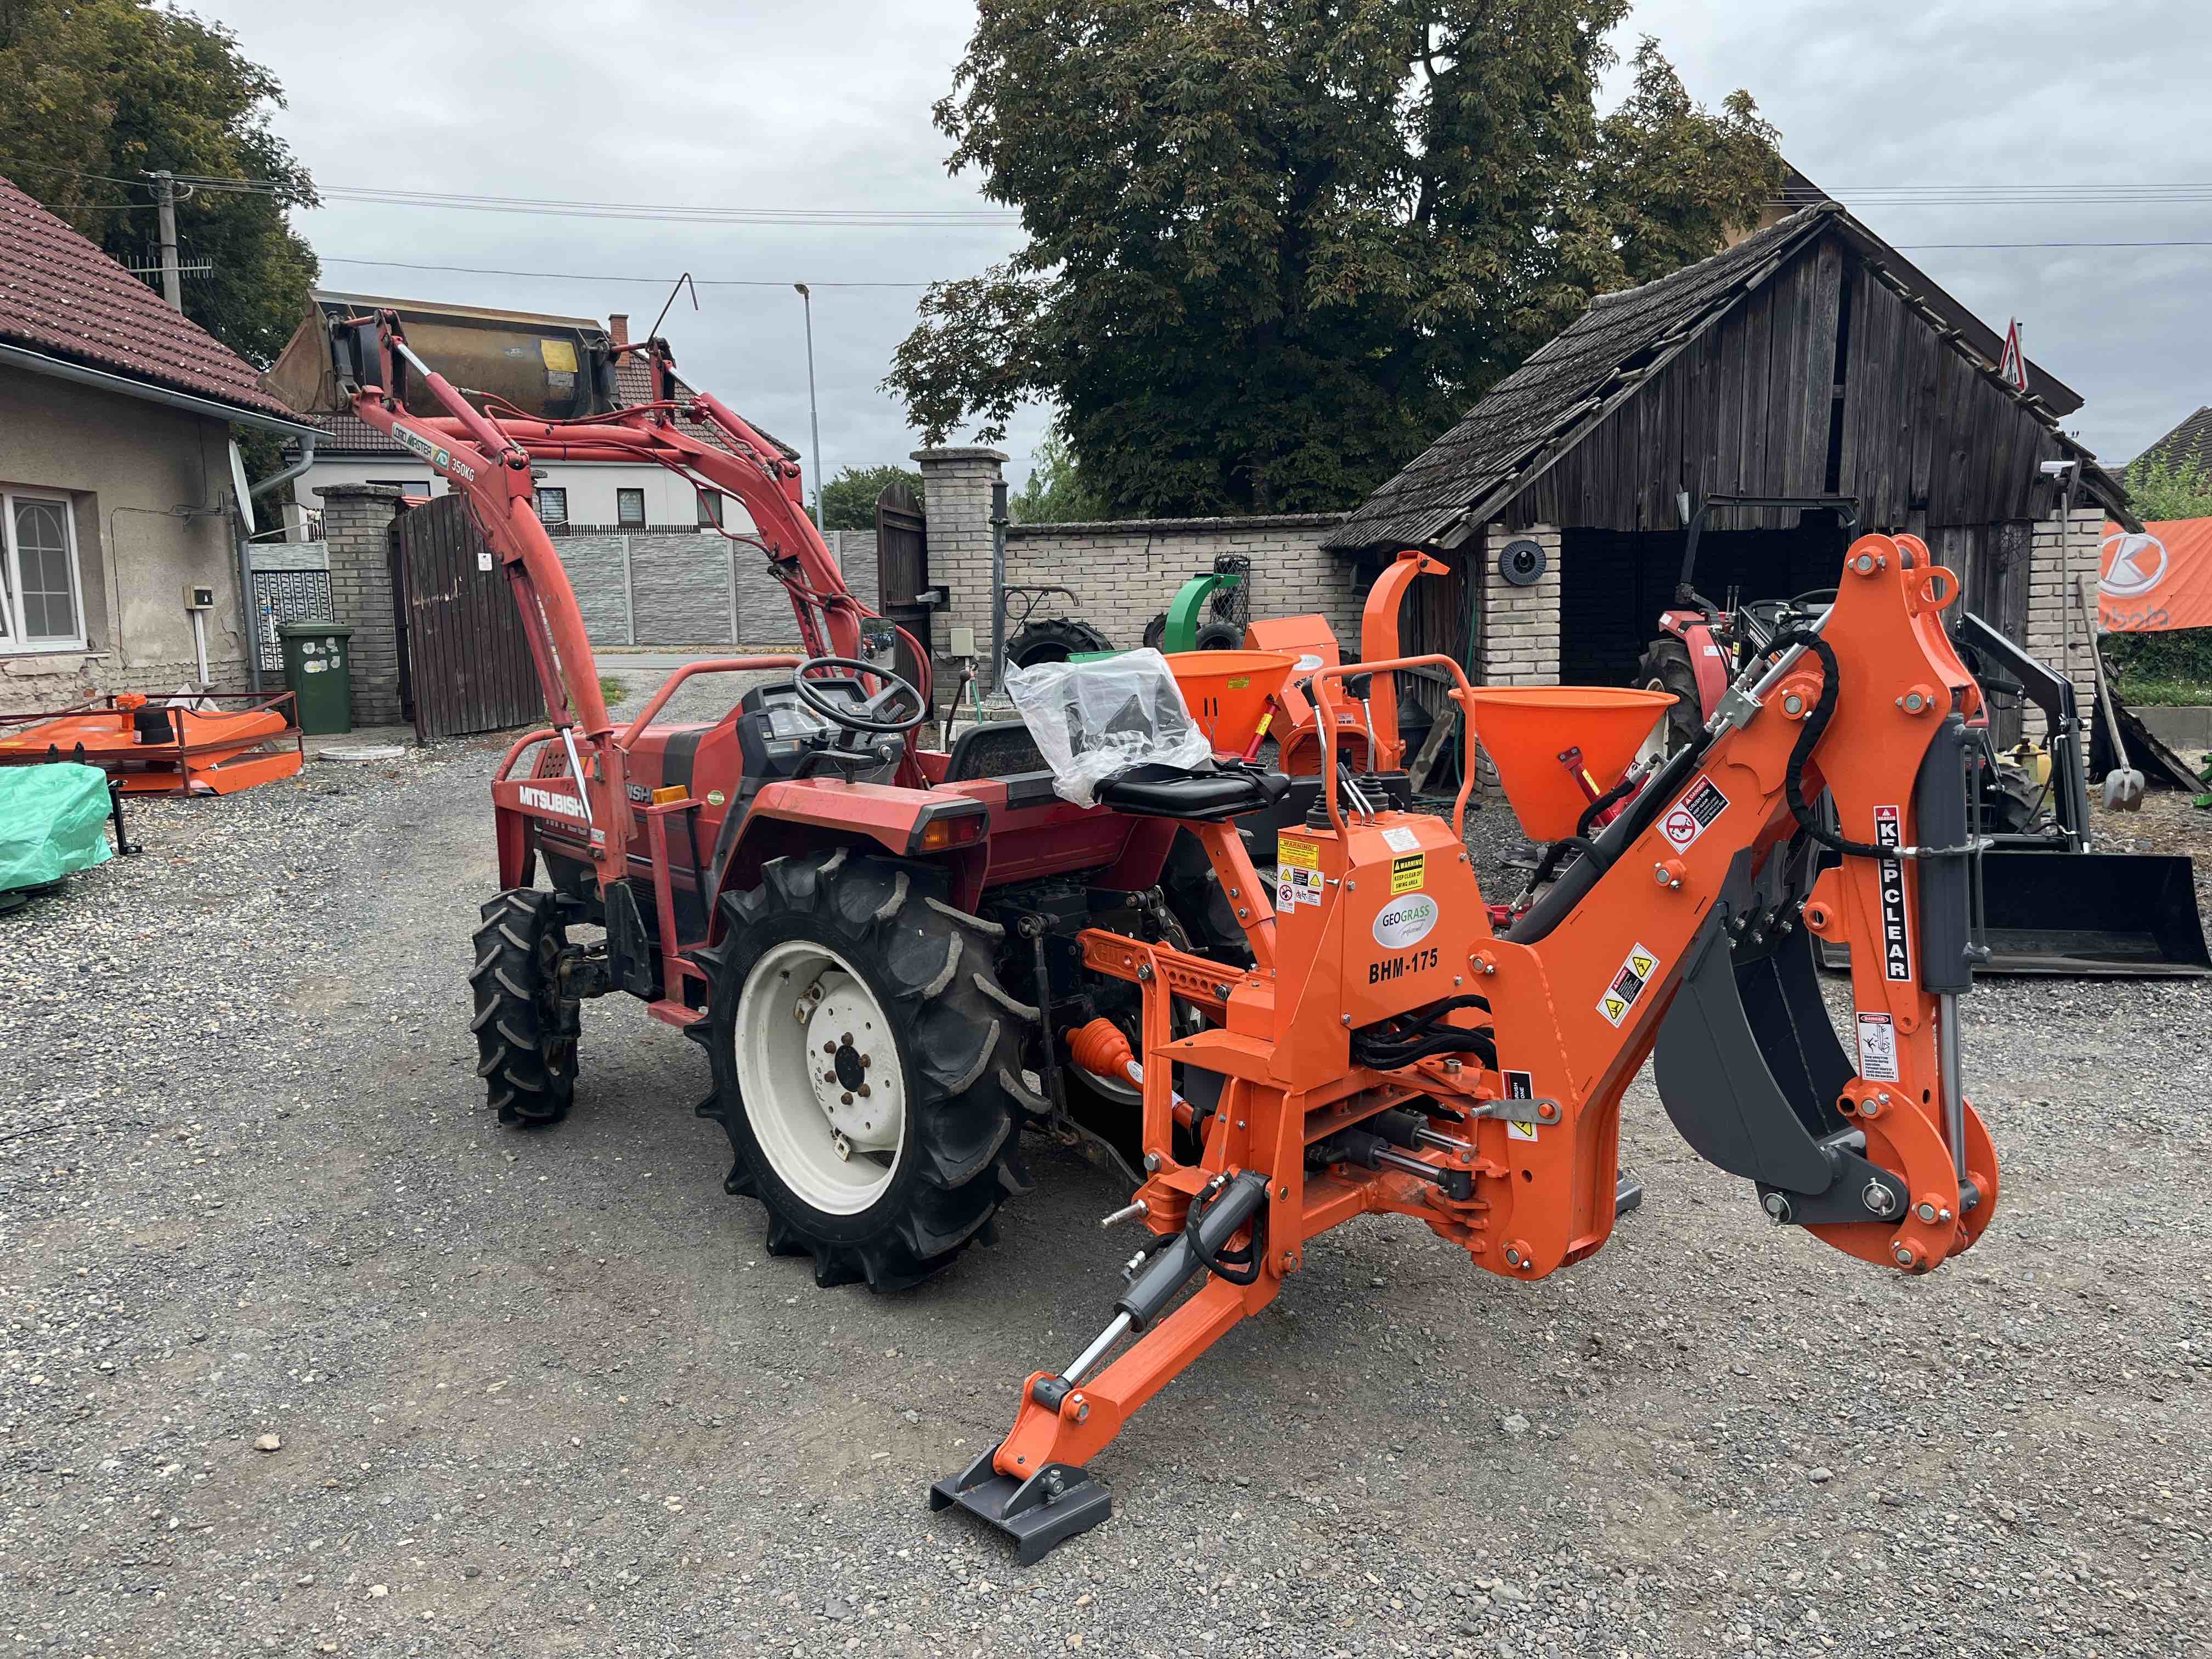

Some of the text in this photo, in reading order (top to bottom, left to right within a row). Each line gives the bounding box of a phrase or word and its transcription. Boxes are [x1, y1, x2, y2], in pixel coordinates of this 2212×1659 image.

[451, 458, 475, 482] 350KG
[1689, 781, 1706, 799] DANGER
[1700, 788, 1711, 799] RISK
[519, 786, 586, 819] MITSUBISH
[1400, 859, 1423, 870] WARNING
[1383, 905, 1430, 927] GEOGRASS
[1884, 889, 1905, 976] CLEAR
[1369, 947, 1438, 984] BHM-175
